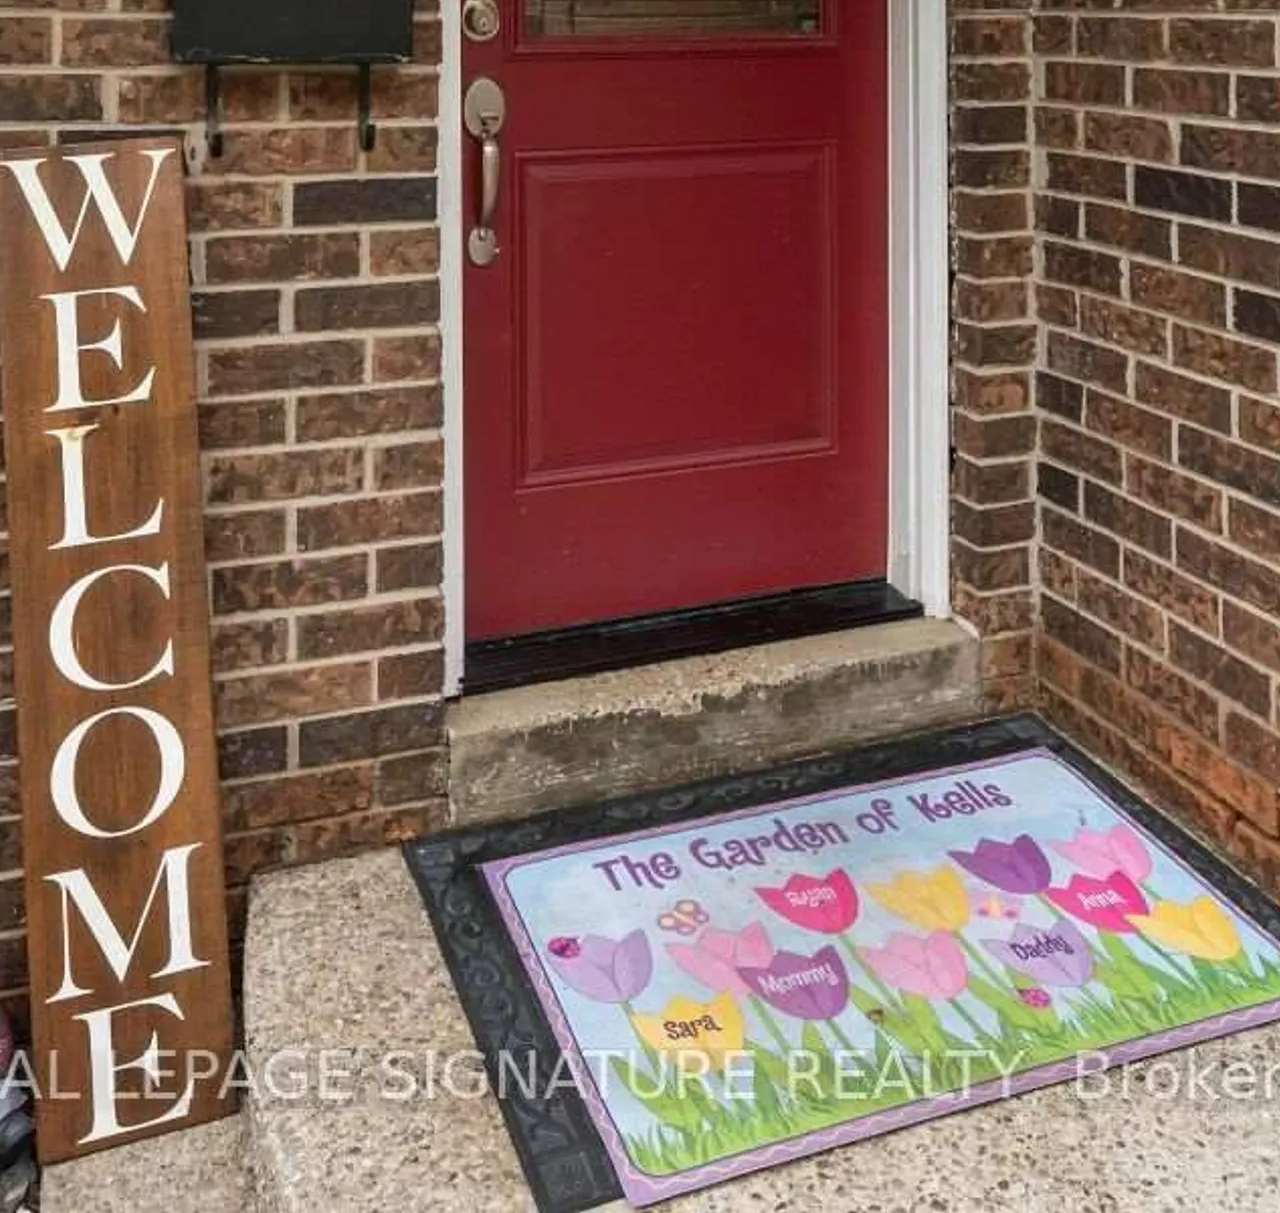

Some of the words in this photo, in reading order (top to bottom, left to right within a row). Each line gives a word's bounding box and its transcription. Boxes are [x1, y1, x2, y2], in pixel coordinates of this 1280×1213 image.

[592, 851, 681, 891] The
[689, 818, 851, 870] Garden
[856, 798, 899, 835] of
[907, 780, 1013, 823] Kells
[1009, 930, 1075, 960] Daddy
[757, 962, 840, 995] Mommy
[663, 1013, 724, 1041] Sara
